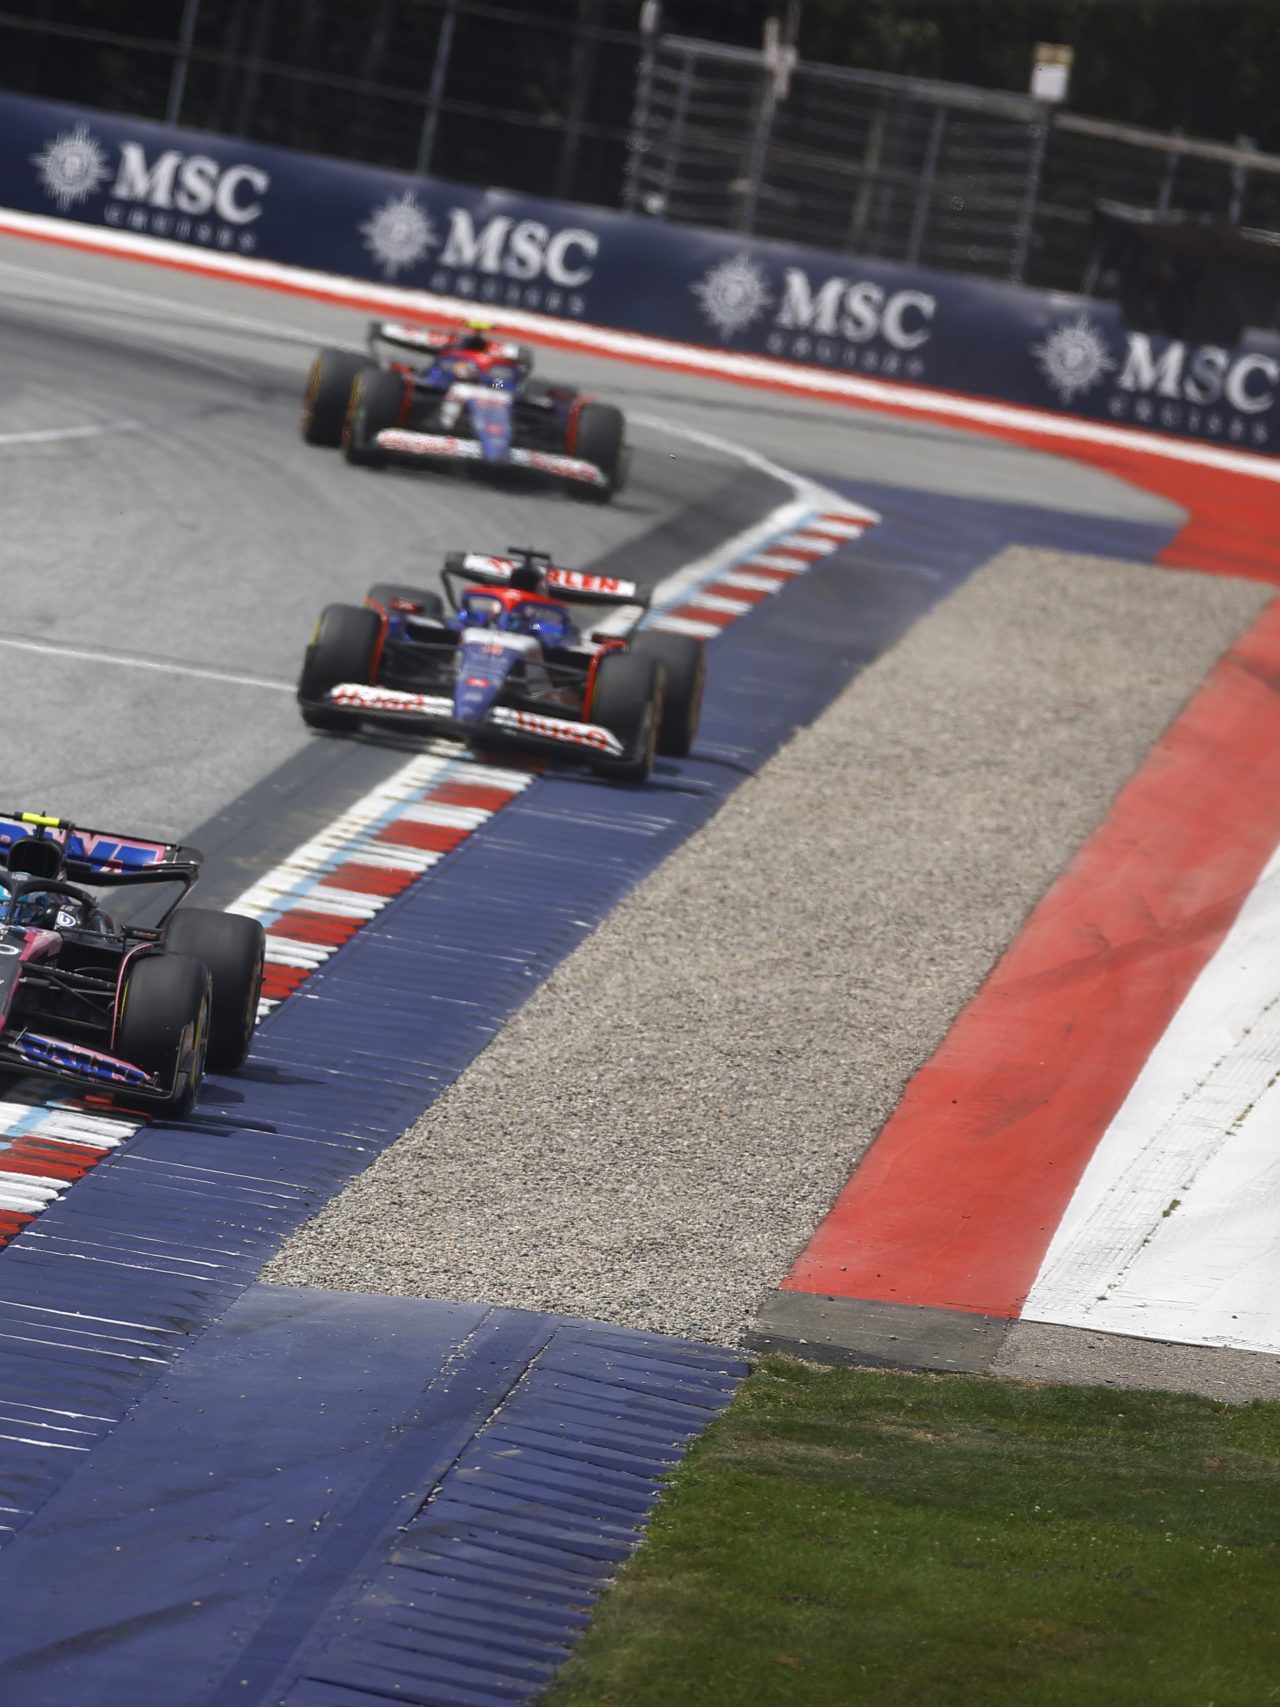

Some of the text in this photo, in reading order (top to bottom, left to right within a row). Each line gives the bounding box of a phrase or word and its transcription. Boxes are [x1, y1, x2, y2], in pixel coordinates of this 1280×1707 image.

[110, 140, 269, 224] MSC
[439, 207, 599, 287] MSC
[775, 266, 937, 349] MSC
[1116, 331, 1279, 414] MSC
[545, 564, 622, 593] RLEN
